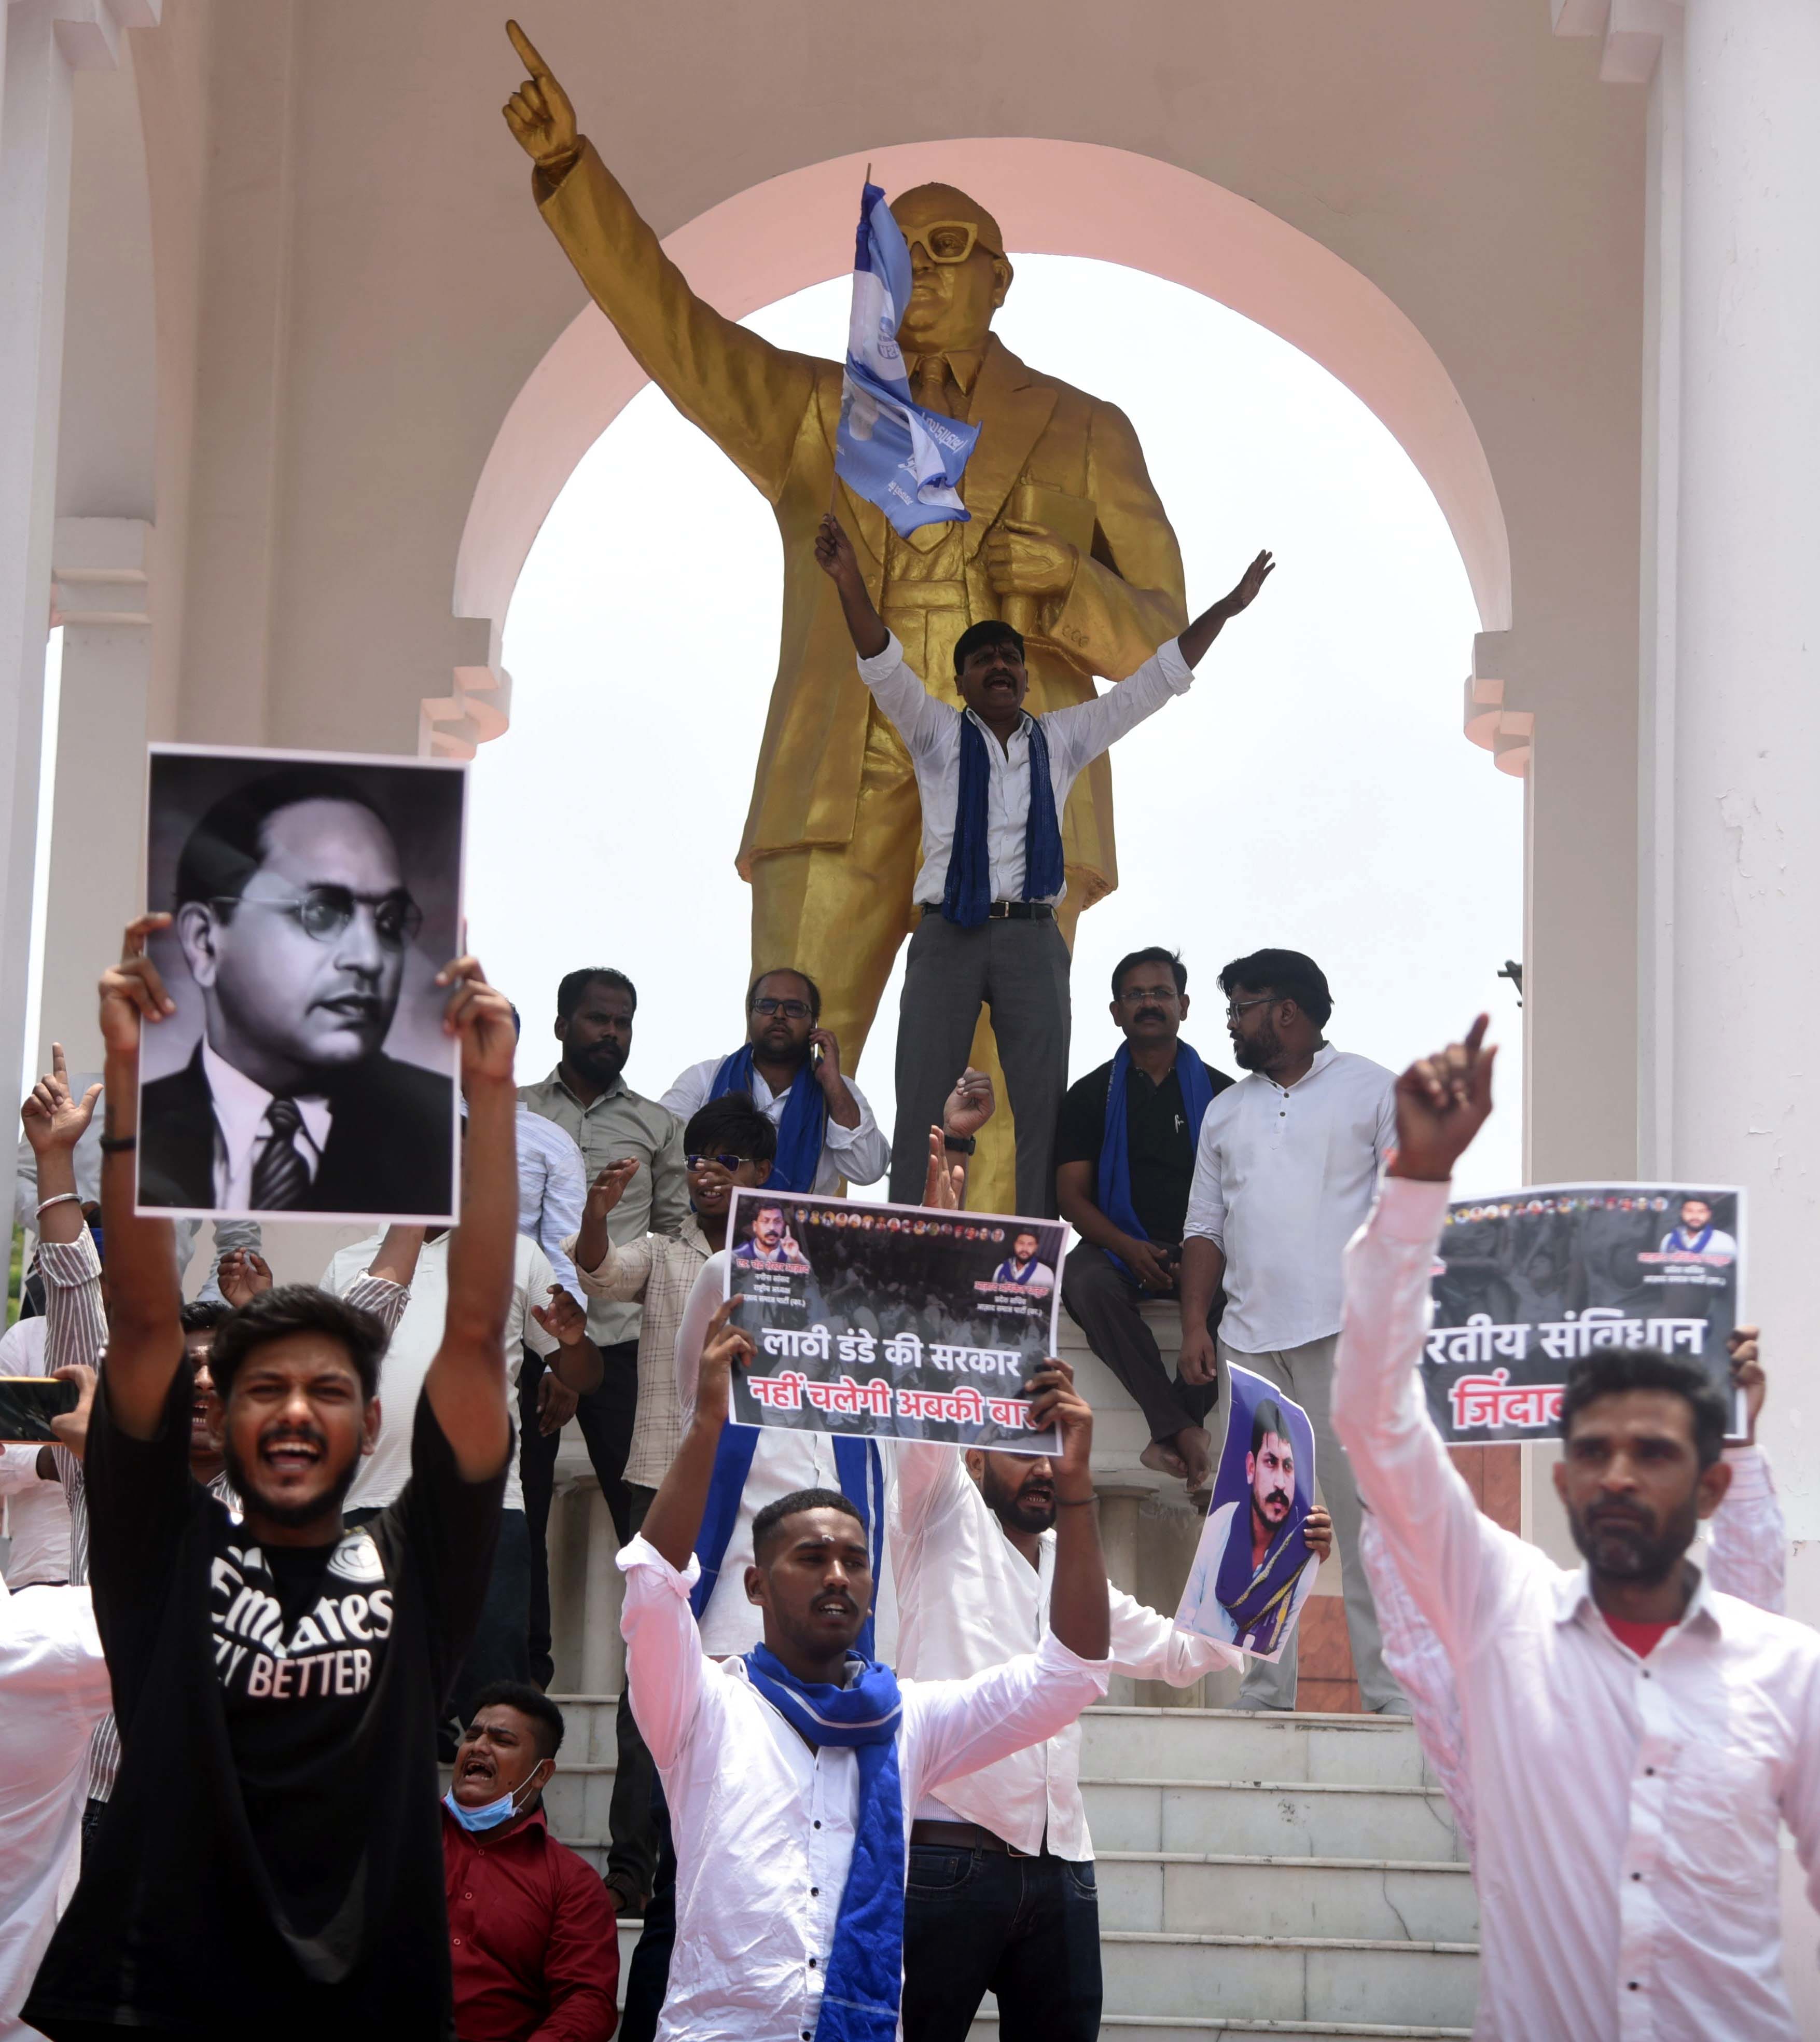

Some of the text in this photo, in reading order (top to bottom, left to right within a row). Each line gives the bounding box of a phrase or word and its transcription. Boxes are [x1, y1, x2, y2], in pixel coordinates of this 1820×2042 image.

[762, 1324, 1021, 1377] लाठी डंडे की सरकार
[1417, 1313, 1531, 1364] रतीय
[747, 1370, 807, 1410] नहीं
[808, 1376, 892, 1417] चलेगी
[896, 1386, 984, 1426] अबकी
[1448, 1367, 1566, 1429] जिंदा
[247, 1649, 372, 1698] BETTER
